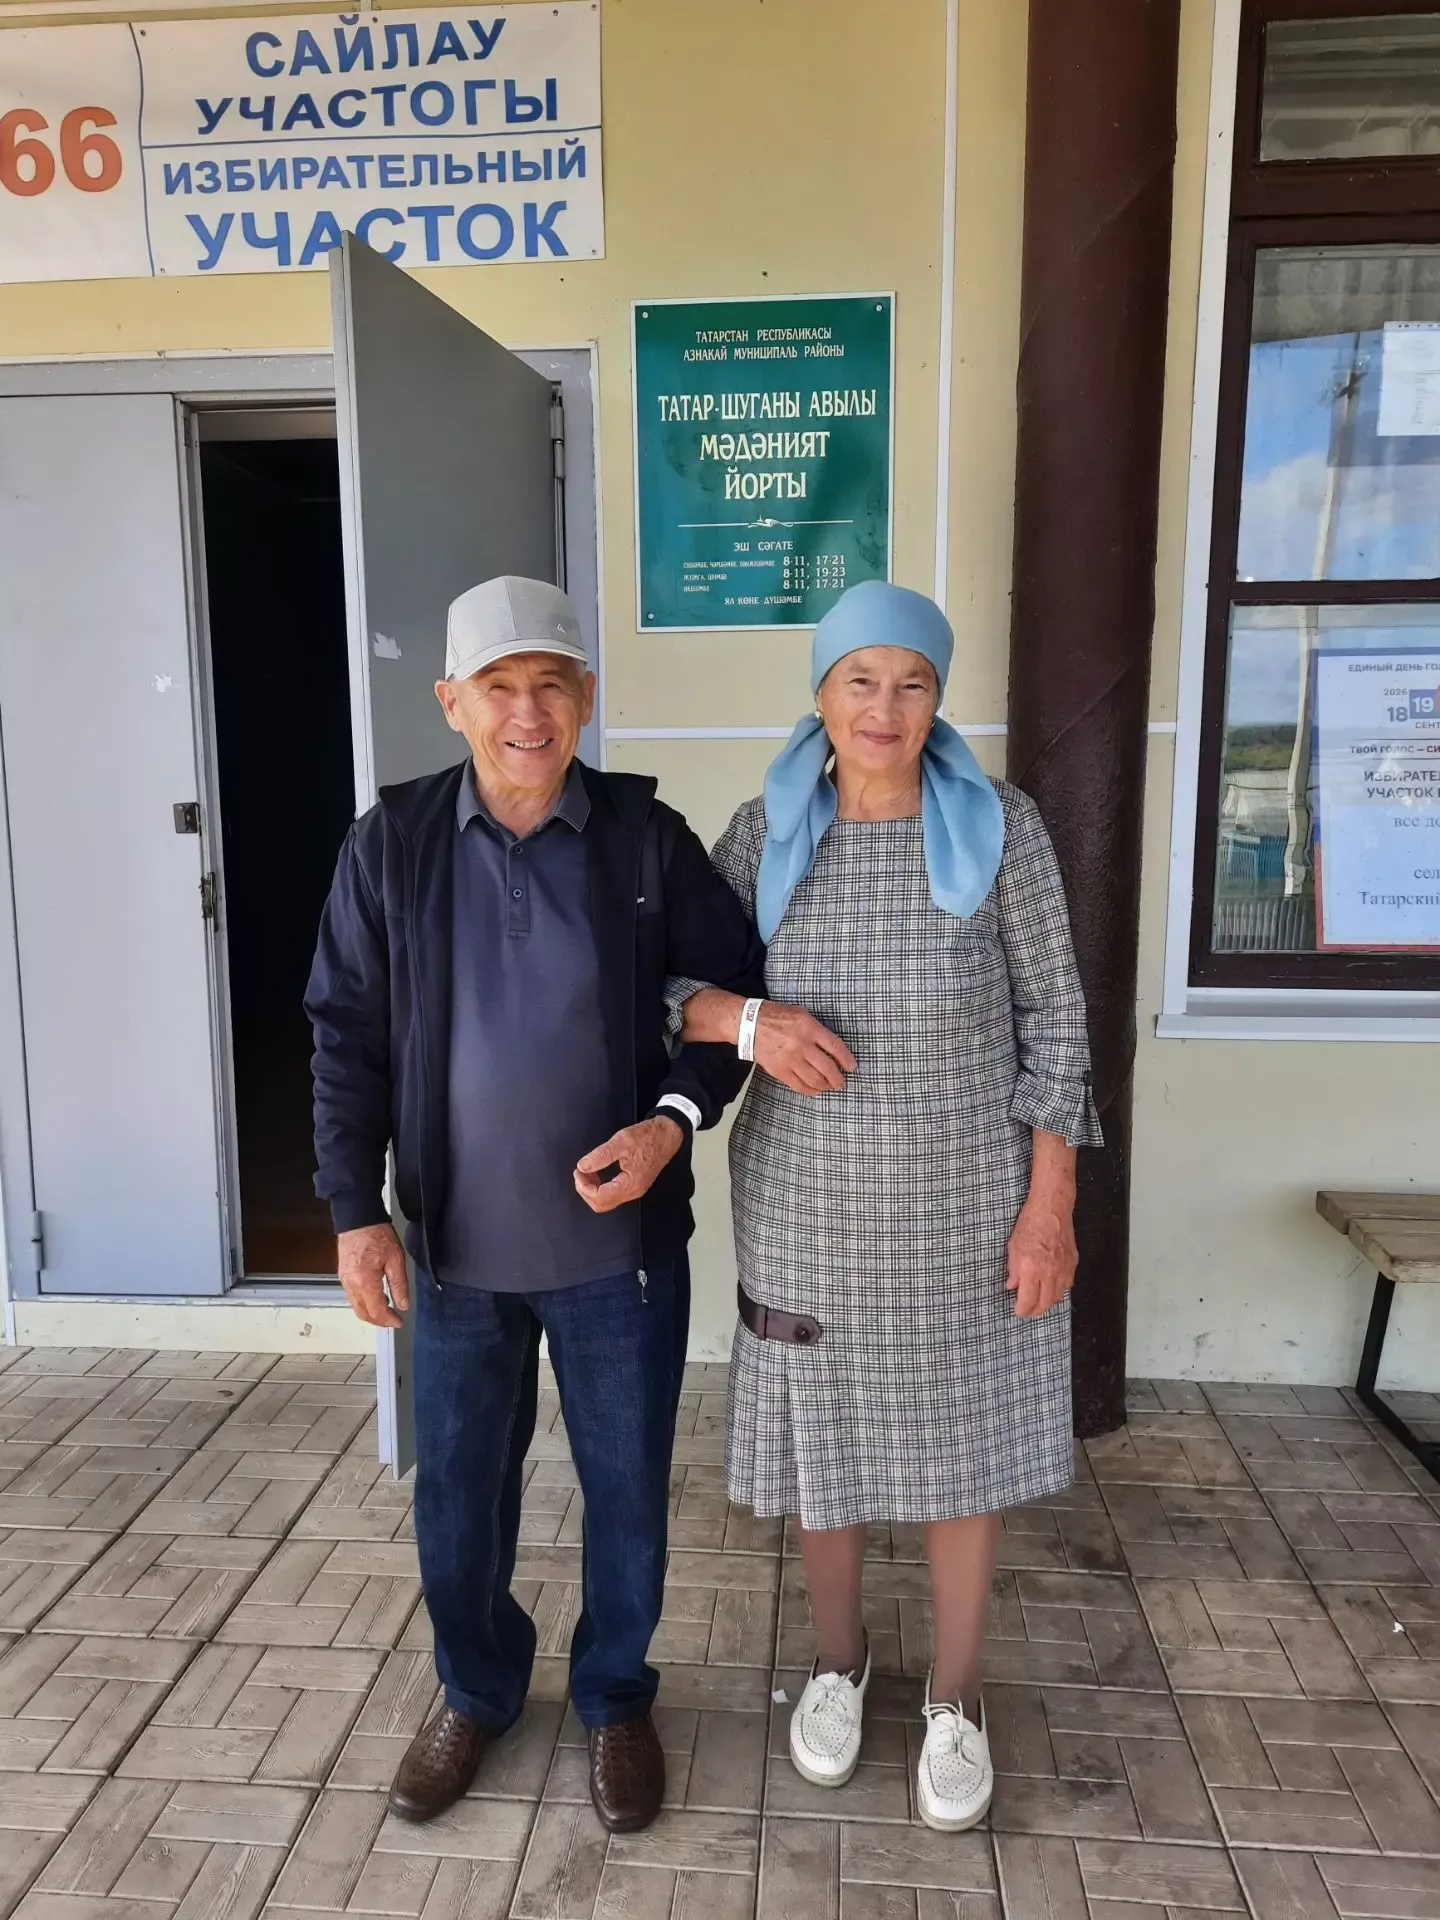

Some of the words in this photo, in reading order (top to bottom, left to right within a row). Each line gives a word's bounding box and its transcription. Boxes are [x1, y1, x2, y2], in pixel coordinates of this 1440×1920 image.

[245, 14, 507, 78] САЙЛАУ
[195, 78, 558, 135] УЧАСТОГЫ
[0, 106, 122, 197] 66
[163, 137, 587, 195] ИЗБИРАТЕЛЬНЫЙ
[185, 201, 568, 271] УЧАСТОК
[696, 330, 748, 343] ТАТАРСТАН
[757, 327, 832, 341] РЕСПУБЛИКАСЫ
[683, 345, 727, 361] АЗНАКАЙ
[734, 346, 798, 360] МУНИЦИПАЛЬ
[804, 343, 845, 357] РАЙОНЫ
[658, 392, 801, 421] ТАТАР-ШУГАНЫ
[808, 389, 877, 417] АВЫЛЫ
[700, 431, 830, 462] МӘДӘНИЯТ
[724, 465, 806, 500] ЙОРТЫ
[734, 542, 750, 552] ЭШ
[758, 541, 794, 551] СӘГАТЕ
[815, 555, 845, 565] 17-21
[815, 567, 846, 577] 19-23
[815, 579, 845, 589] 17-21
[724, 597, 735, 606] ЯЛ
[1348, 663, 1393, 672] ЕДИНЫЙ
[1395, 663, 1423, 672] ДЕНЬ
[1425, 663, 1440, 671] ГО
[1383, 688, 1408, 696] 2026
[1386, 706, 1408, 722] 18
[1412, 696, 1434, 713] 19
[1364, 770, 1440, 782] ИЗБИРАТЕ
[1366, 787, 1433, 798] УЧАСТОК
